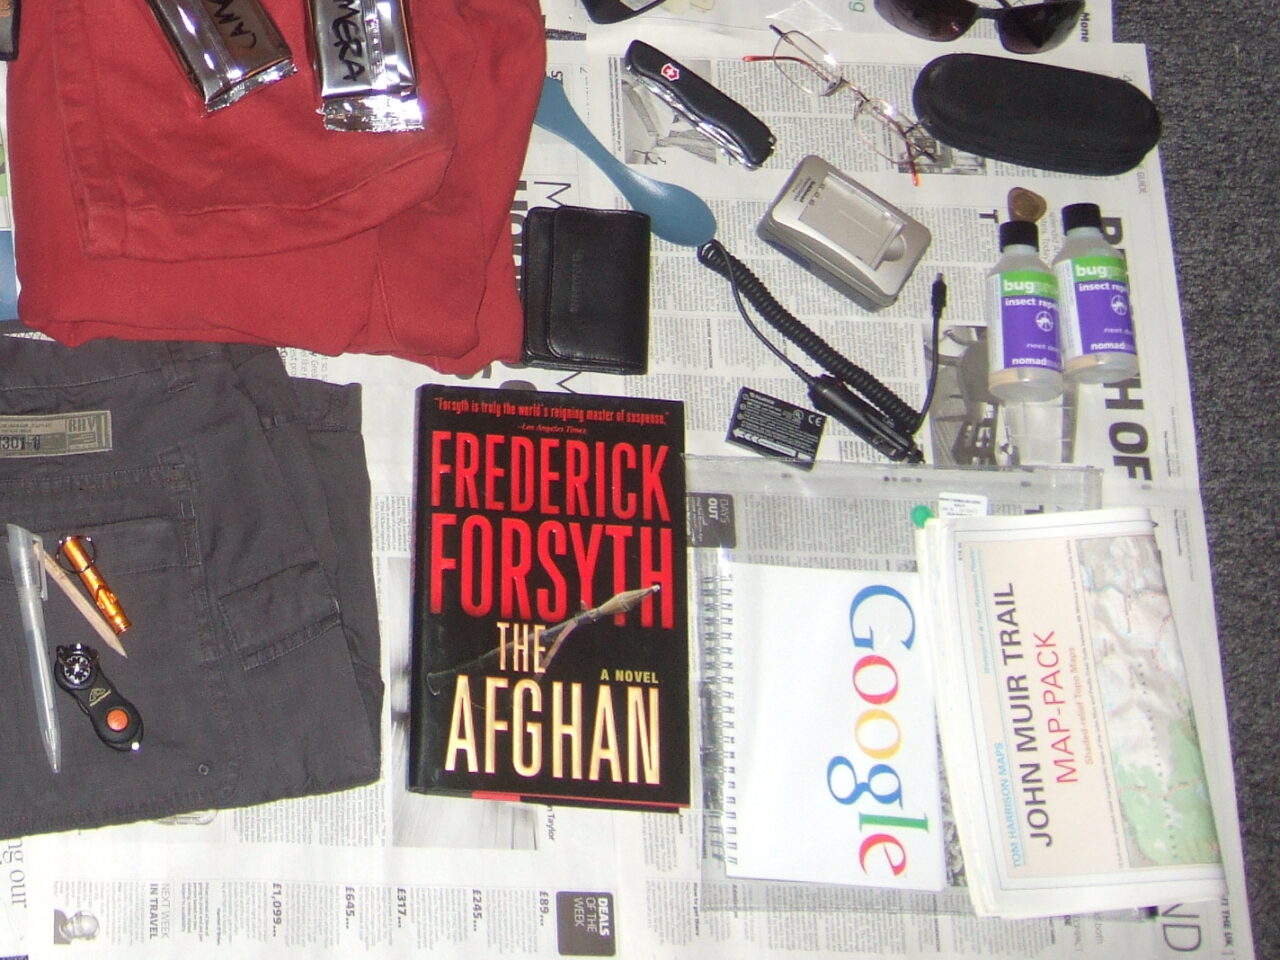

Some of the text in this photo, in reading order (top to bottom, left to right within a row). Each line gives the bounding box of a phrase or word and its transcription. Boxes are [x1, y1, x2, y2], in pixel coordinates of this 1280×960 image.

[1004, 280, 1036, 294] bug
[1075, 265, 1107, 278] bug
[1079, 283, 1110, 292] insect
[1005, 298, 1037, 307] insect
[1012, 358, 1048, 366] nomad
[1091, 342, 1126, 351] nomad
[472, 402, 480, 413] is
[481, 401, 501, 418] truly
[503, 401, 517, 415] the
[518, 403, 549, 418] world's
[551, 406, 584, 422] reigning
[586, 409, 615, 421] master
[616, 409, 625, 421] of
[536, 424, 588, 434] Angeles Times
[1109, 422, 1153, 481] OF
[431, 430, 672, 522] FREDERICK
[708, 498, 719, 520] OUT
[720, 499, 729, 523] DAYS
[429, 512, 676, 630] FORSYTH
[496, 621, 548, 674] THE
[600, 669, 660, 684] A NOVEL
[993, 583, 1053, 848] JOHN MUIR TRAIL
[1033, 630, 1079, 785] MAP-PACK
[1068, 647, 1094, 766] Shaded-relief Topo Maps
[444, 674, 661, 785] AFGHAN
[827, 584, 930, 877] Google
[993, 742, 1022, 869] TOM HARRISON MAPS
[546, 814, 556, 841] Taylor
[9, 869, 28, 909] our
[149, 883, 159, 939] IN TRAVEL
[160, 883, 171, 939] NEXT WEEK
[573, 897, 586, 927] WEEK
[586, 897, 598, 932] OF THE
[598, 897, 610, 936] DEALS
[1222, 911, 1234, 947] THE UK
